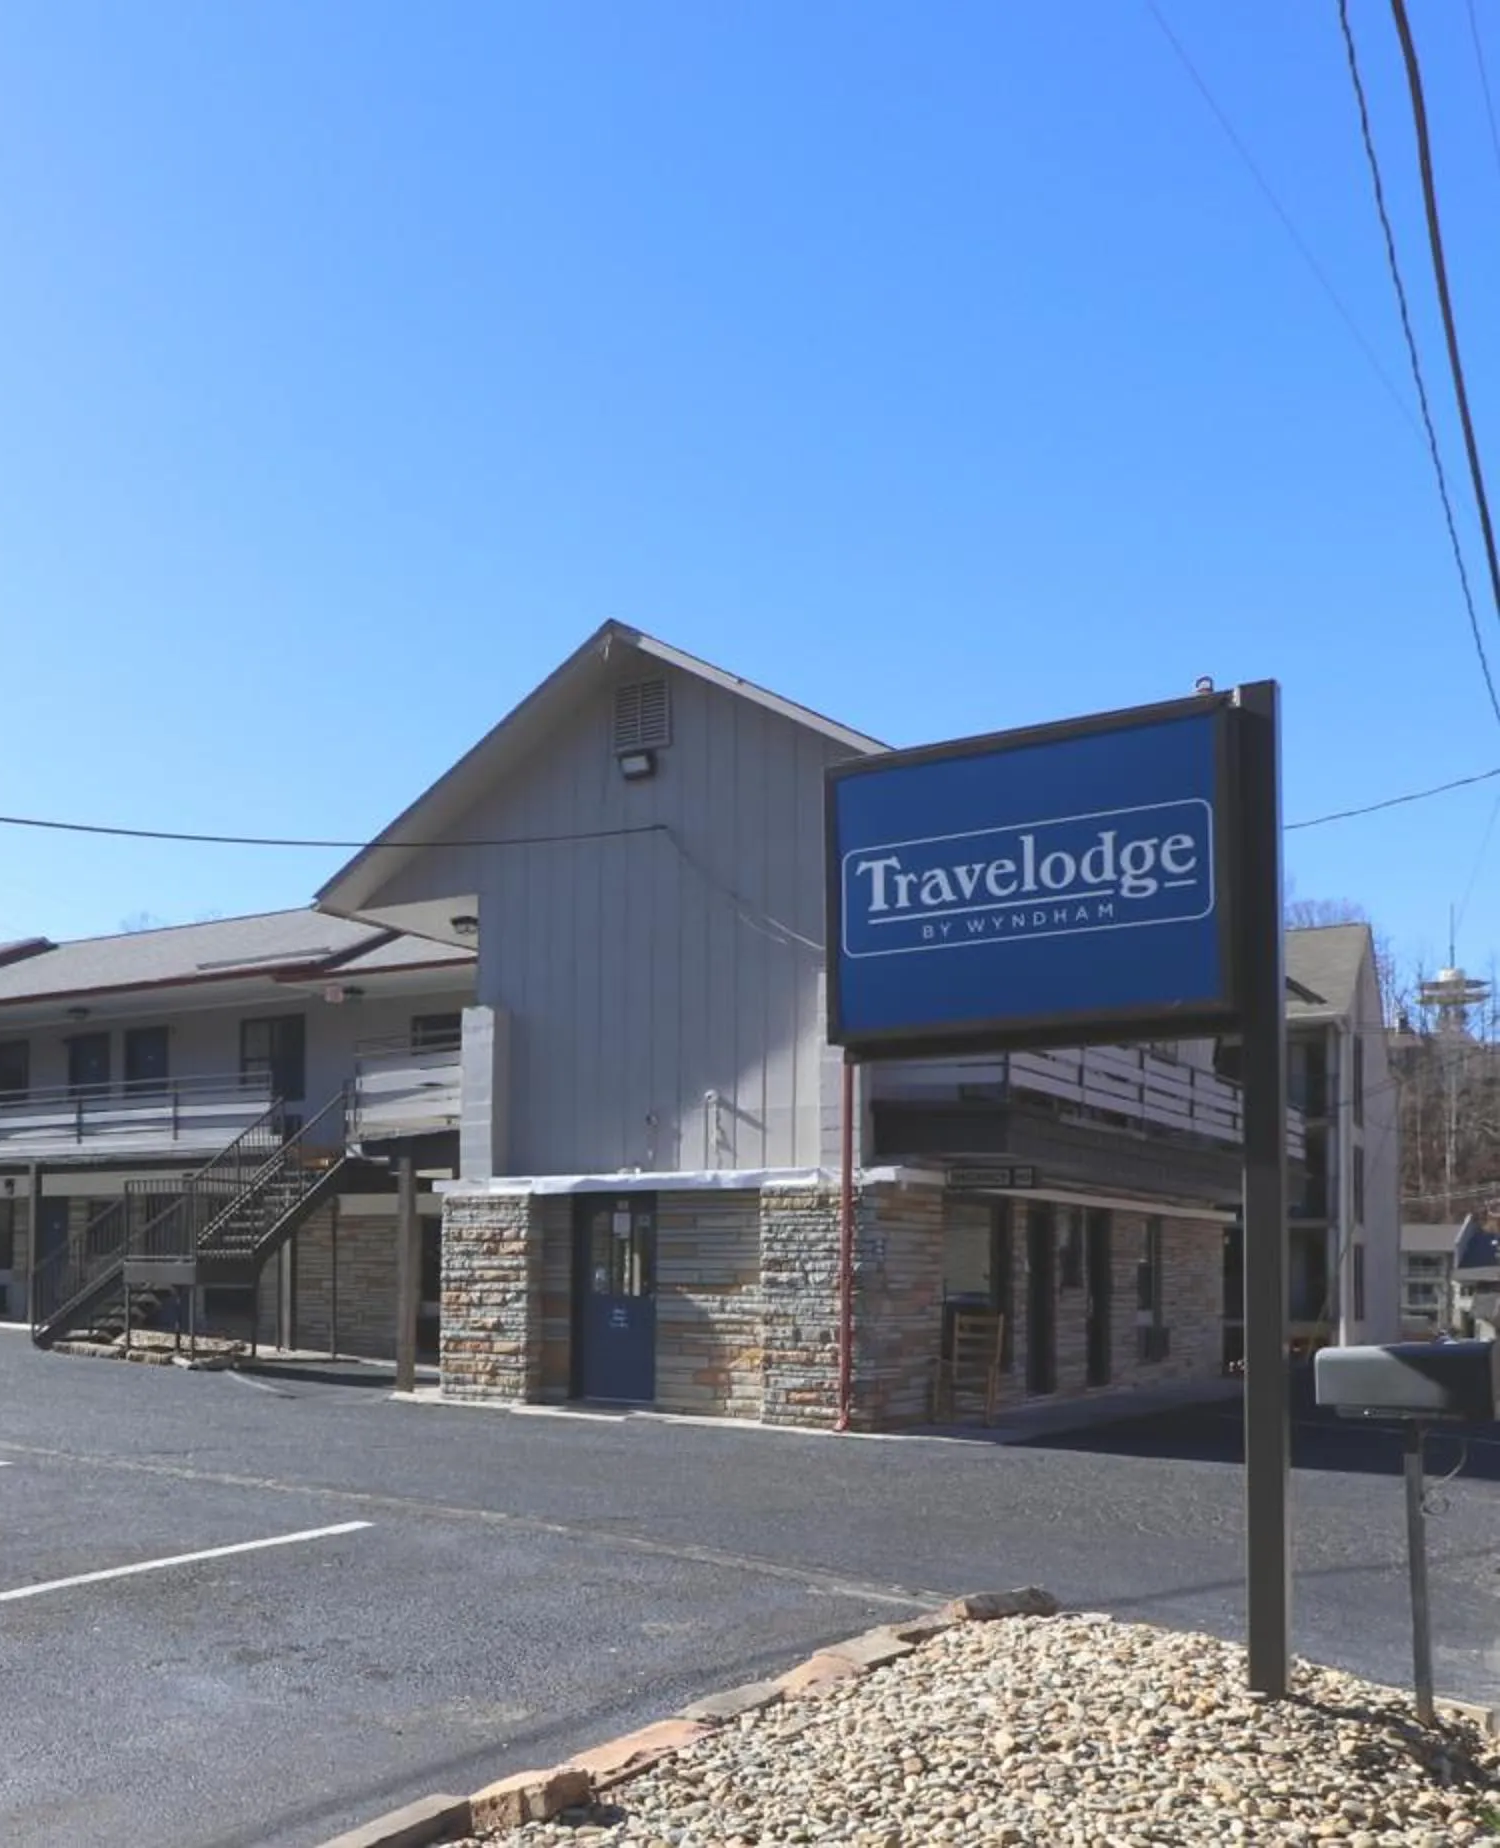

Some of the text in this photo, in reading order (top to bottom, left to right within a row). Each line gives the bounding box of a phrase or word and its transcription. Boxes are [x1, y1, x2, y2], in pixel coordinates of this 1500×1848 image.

[855, 830, 1198, 912] Travelodge
[922, 903, 1114, 939] BY WYNDHAM
